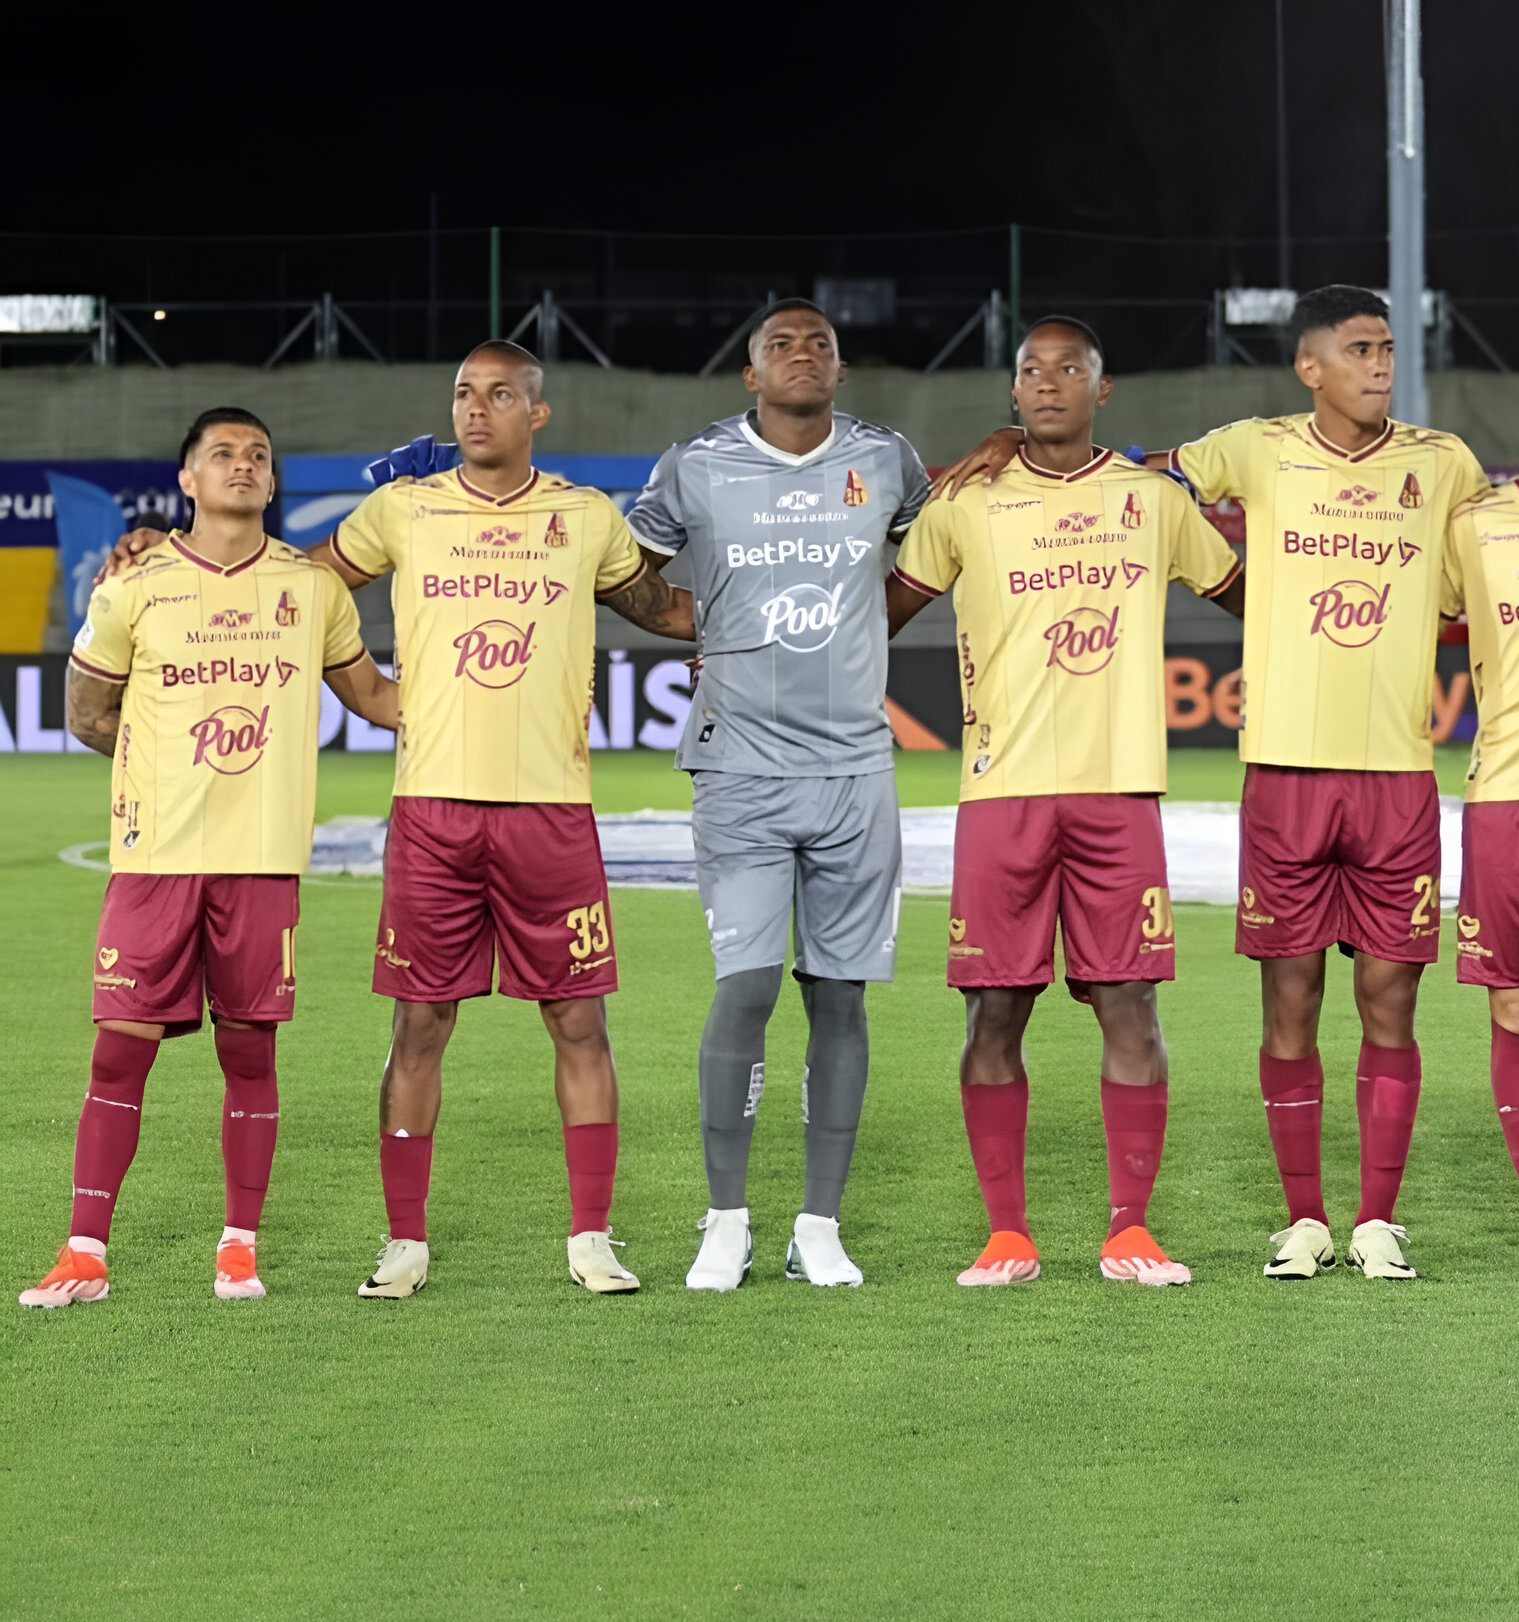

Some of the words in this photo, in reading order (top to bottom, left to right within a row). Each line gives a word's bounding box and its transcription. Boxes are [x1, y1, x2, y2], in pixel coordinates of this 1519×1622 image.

[727, 538, 841, 569] BetPlay
[1283, 530, 1393, 566] BetPlay
[423, 572, 538, 605] BetPlay
[1009, 560, 1117, 595] BetPlay
[760, 583, 844, 646] Pool
[1309, 583, 1392, 636] Pool
[453, 621, 537, 677] Pool
[1044, 605, 1121, 668] Pool
[162, 656, 271, 687] BetPlay
[189, 705, 271, 767] Pool
[566, 900, 610, 960] 33
